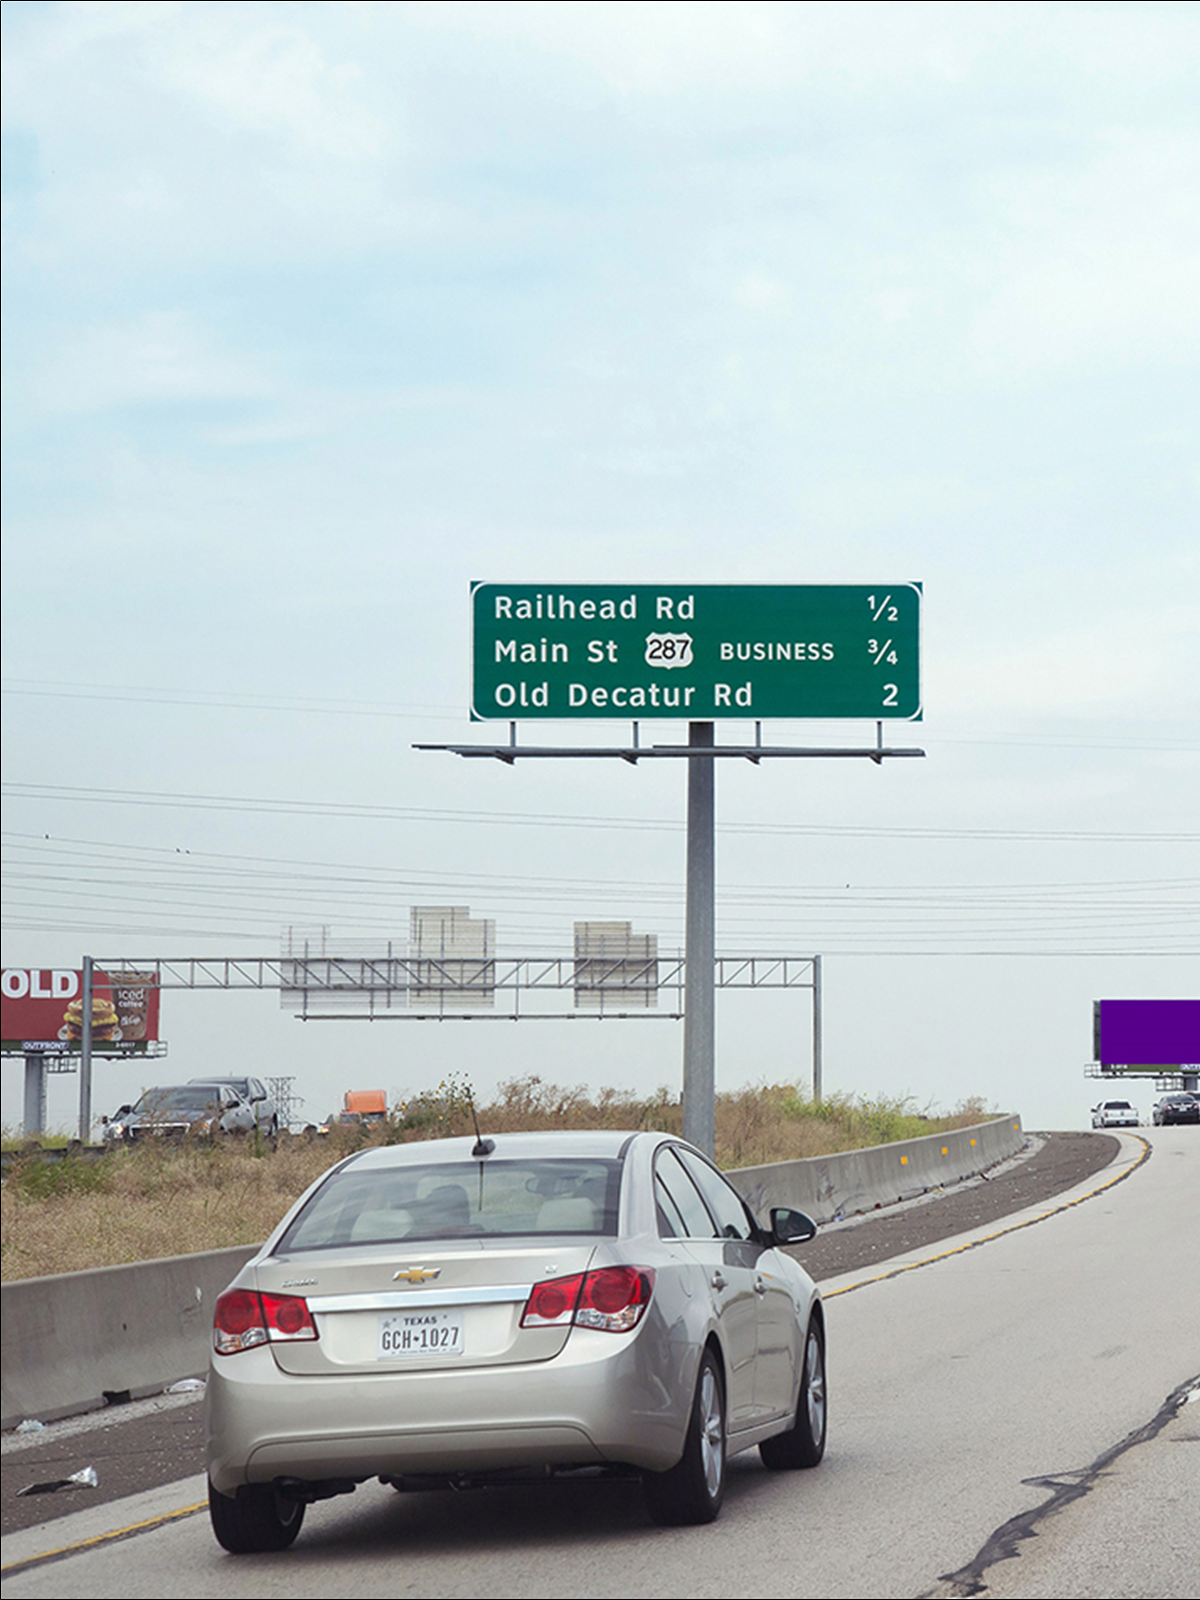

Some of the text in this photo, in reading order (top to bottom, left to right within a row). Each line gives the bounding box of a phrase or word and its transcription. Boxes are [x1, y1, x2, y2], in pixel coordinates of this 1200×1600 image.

[494, 594, 638, 620] Railhead
[655, 594, 696, 620] Rd
[494, 637, 619, 663] Main St
[648, 638, 690, 661] 287
[719, 642, 835, 661] BUSINESS
[494, 682, 899, 707] Old Decatur Rd 2
[1, 970, 79, 998] OLD
[404, 1316, 437, 1326] TEXAS
